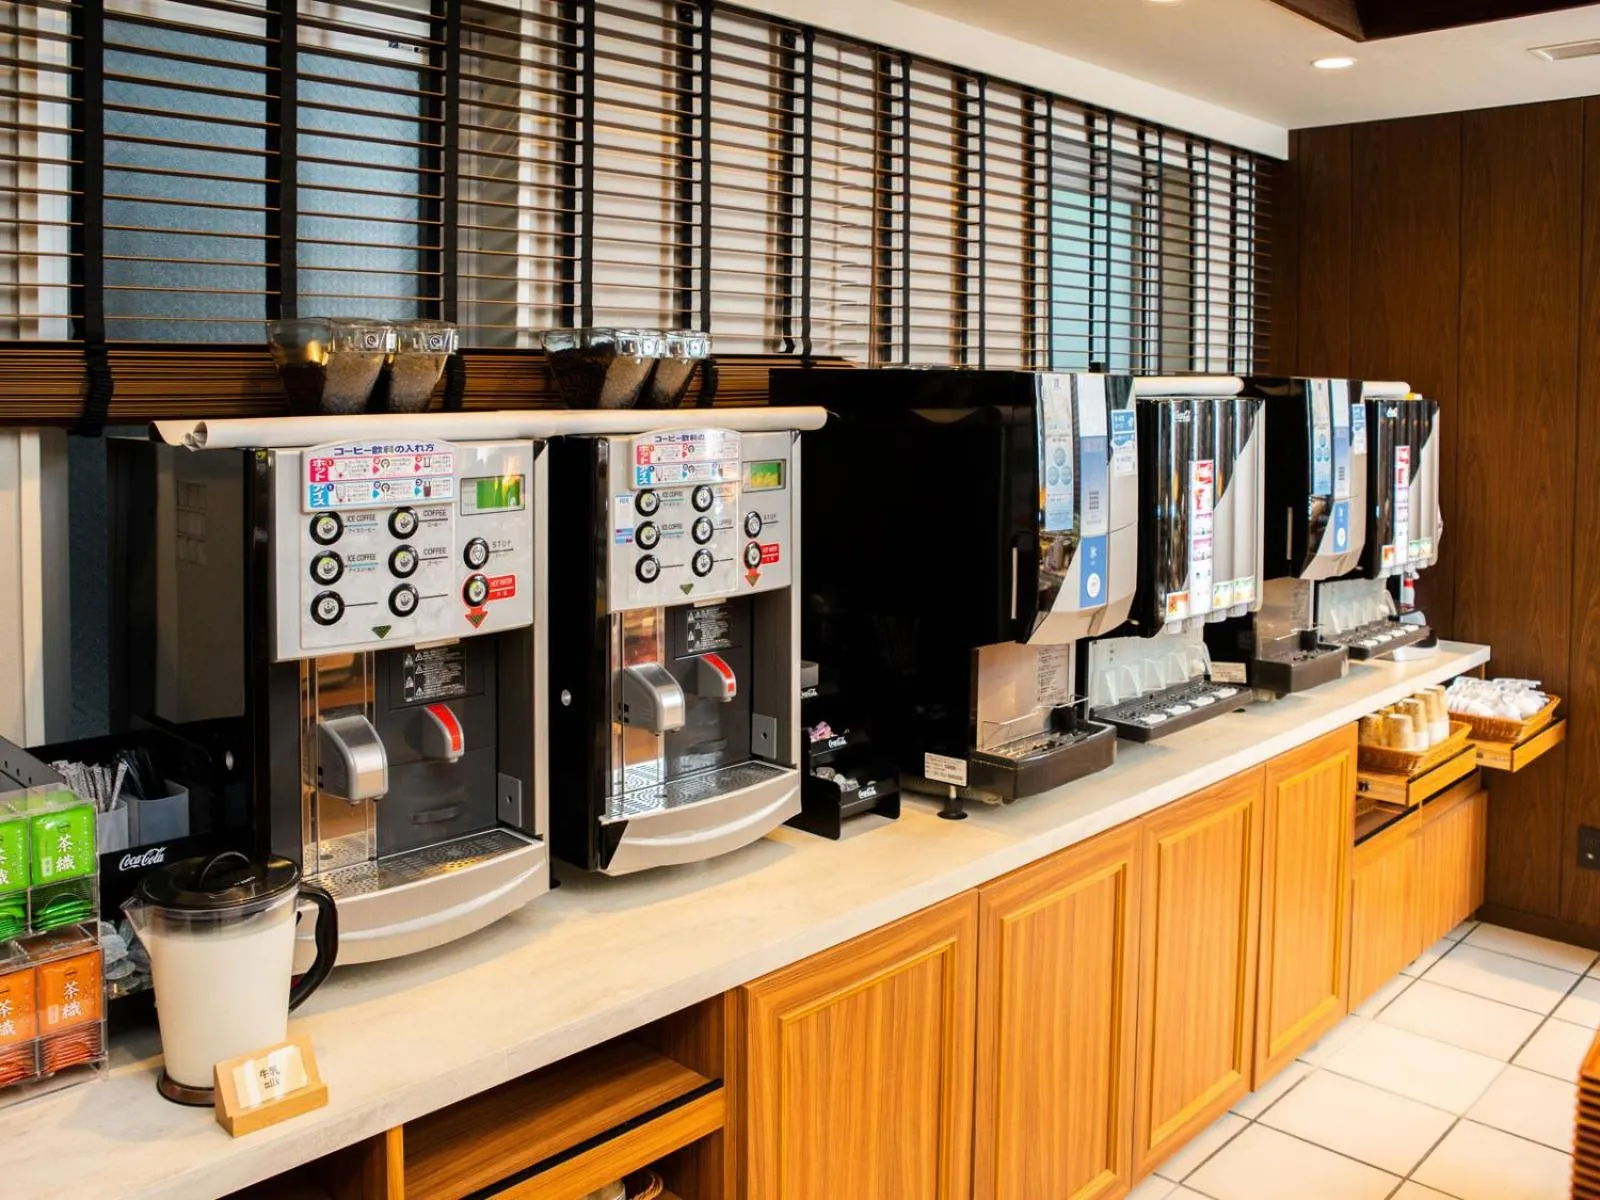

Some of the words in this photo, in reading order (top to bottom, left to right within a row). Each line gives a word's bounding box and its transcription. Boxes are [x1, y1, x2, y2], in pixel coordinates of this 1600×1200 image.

[334, 443, 434, 456] コーヒー飲料の入れ方
[312, 459, 326, 482] ホット
[313, 485, 326, 507] アイス
[423, 509, 447, 517] COFFEE
[423, 547, 447, 555] COFFEE
[357, 553, 376, 561] COFFEE
